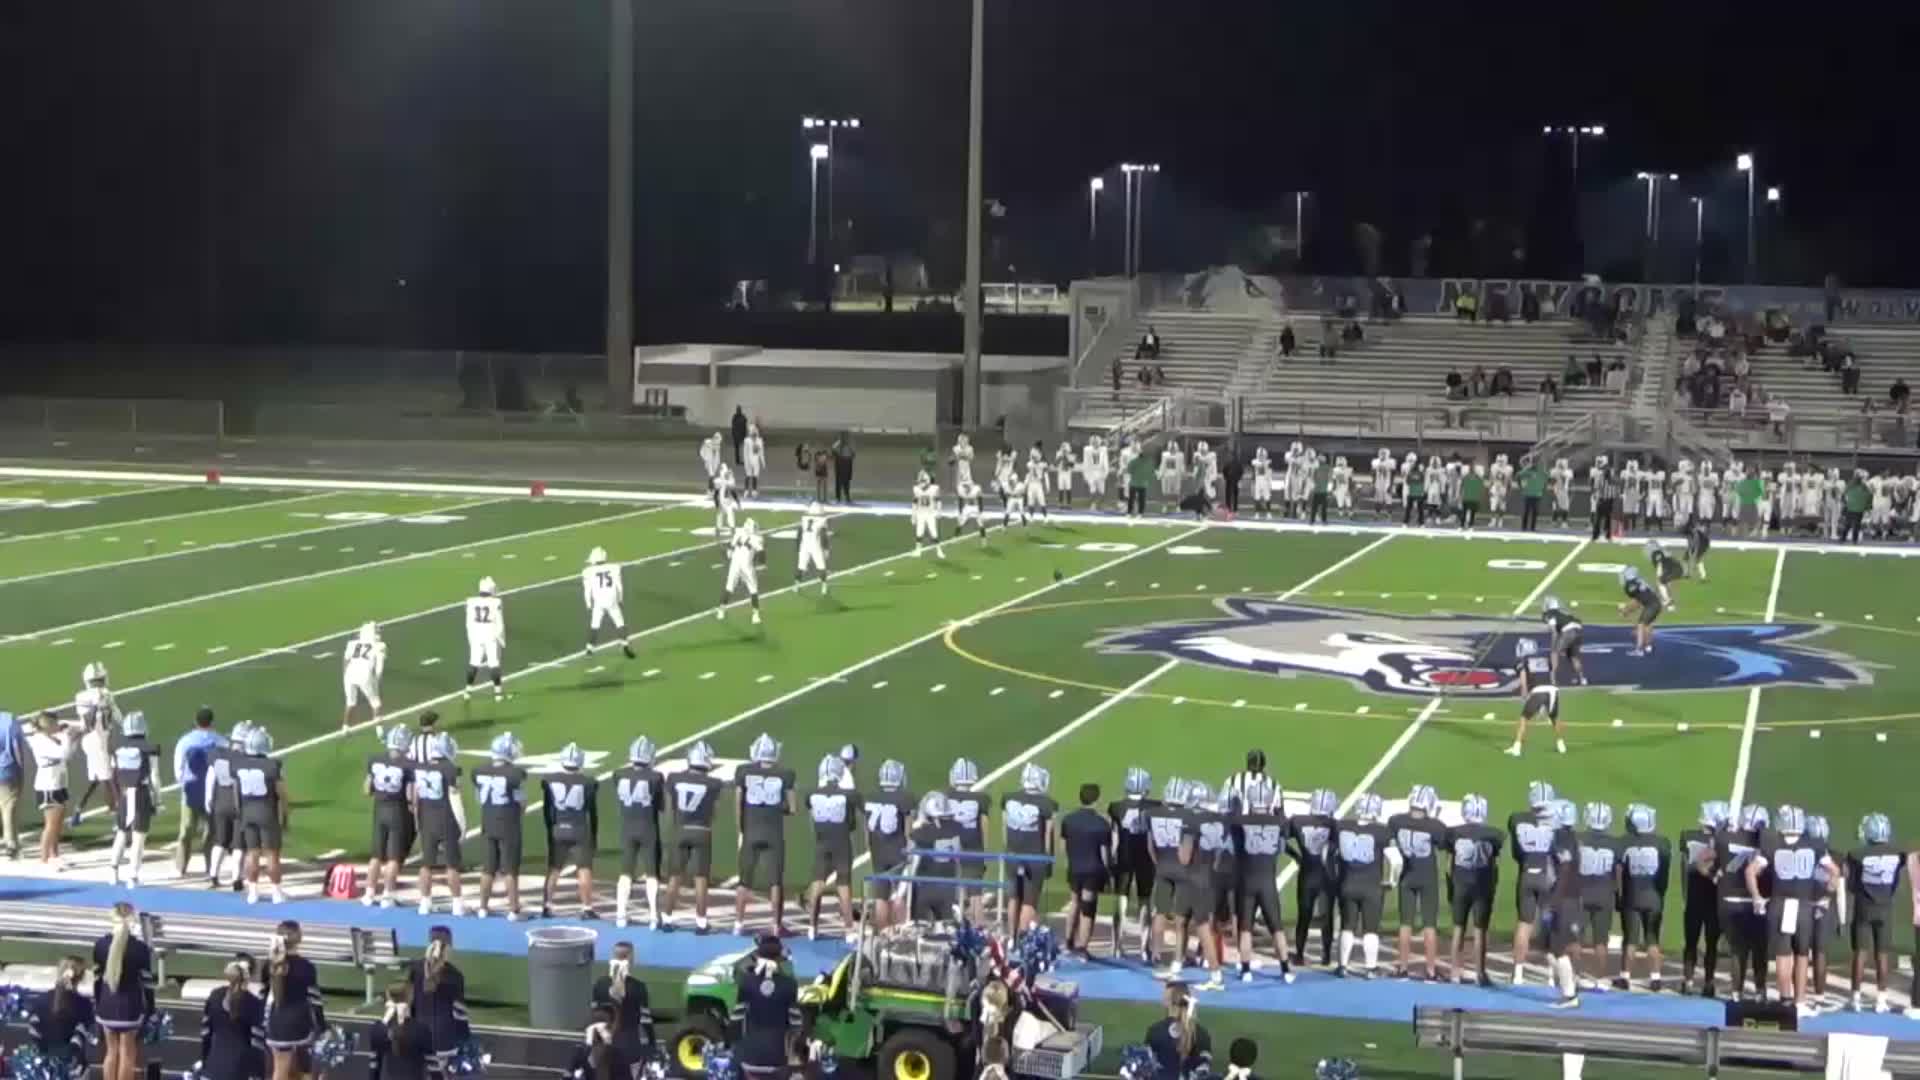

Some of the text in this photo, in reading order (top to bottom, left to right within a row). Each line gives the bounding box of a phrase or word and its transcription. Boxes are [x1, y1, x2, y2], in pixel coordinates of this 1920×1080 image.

[595, 570, 613, 588] 75
[475, 774, 509, 805] 72
[674, 782, 708, 812] 17
